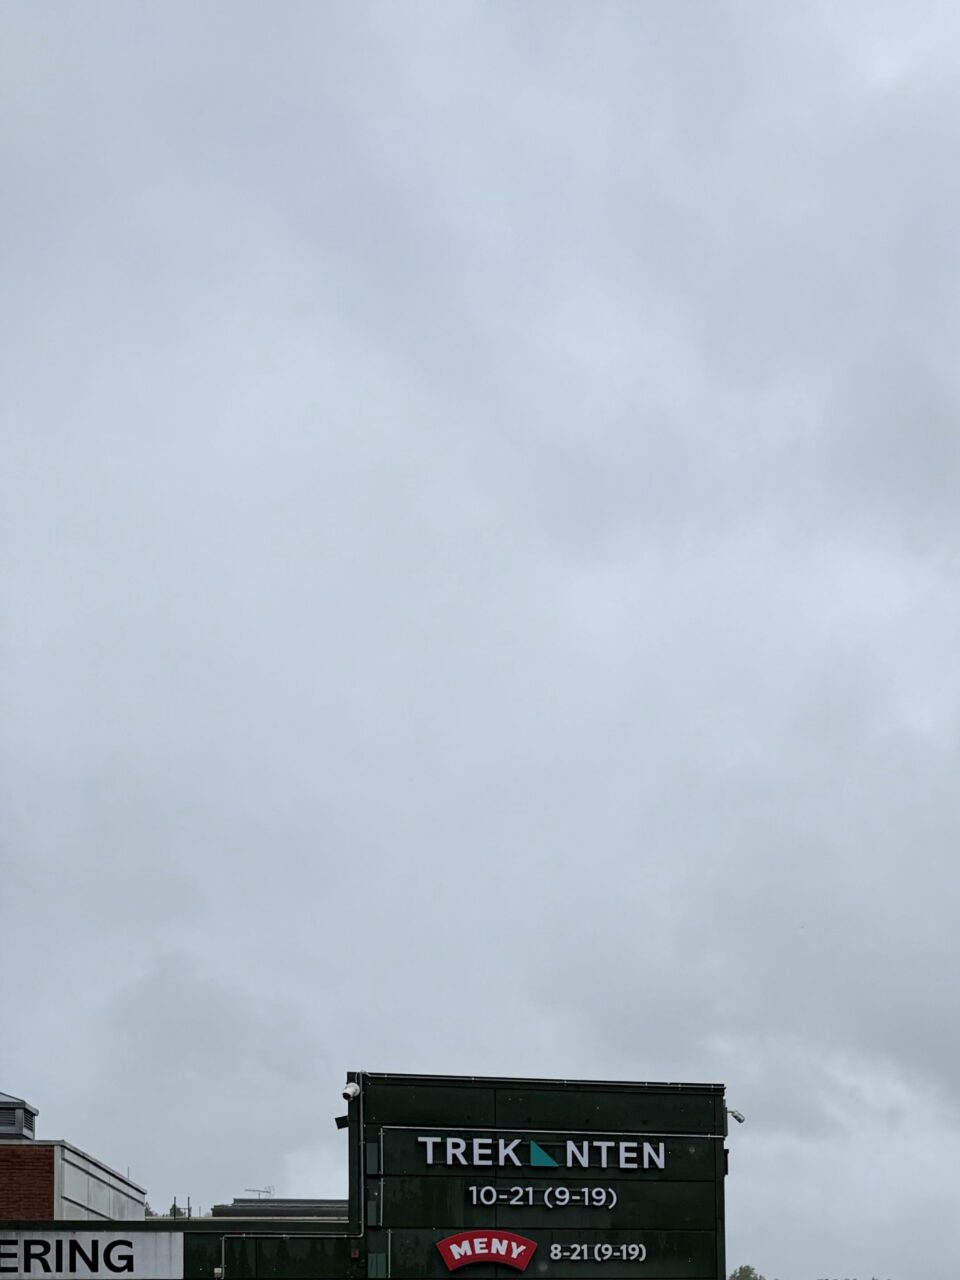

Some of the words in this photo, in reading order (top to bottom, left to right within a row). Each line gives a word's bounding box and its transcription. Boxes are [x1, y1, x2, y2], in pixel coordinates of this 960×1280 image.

[468, 1186, 533, 1206] 10-21
[544, 1187, 617, 1209] (9-19)
[450, 1238, 526, 1260] MENY
[550, 1244, 588, 1261] 8-21
[594, 1243, 647, 1262] (9-19)
